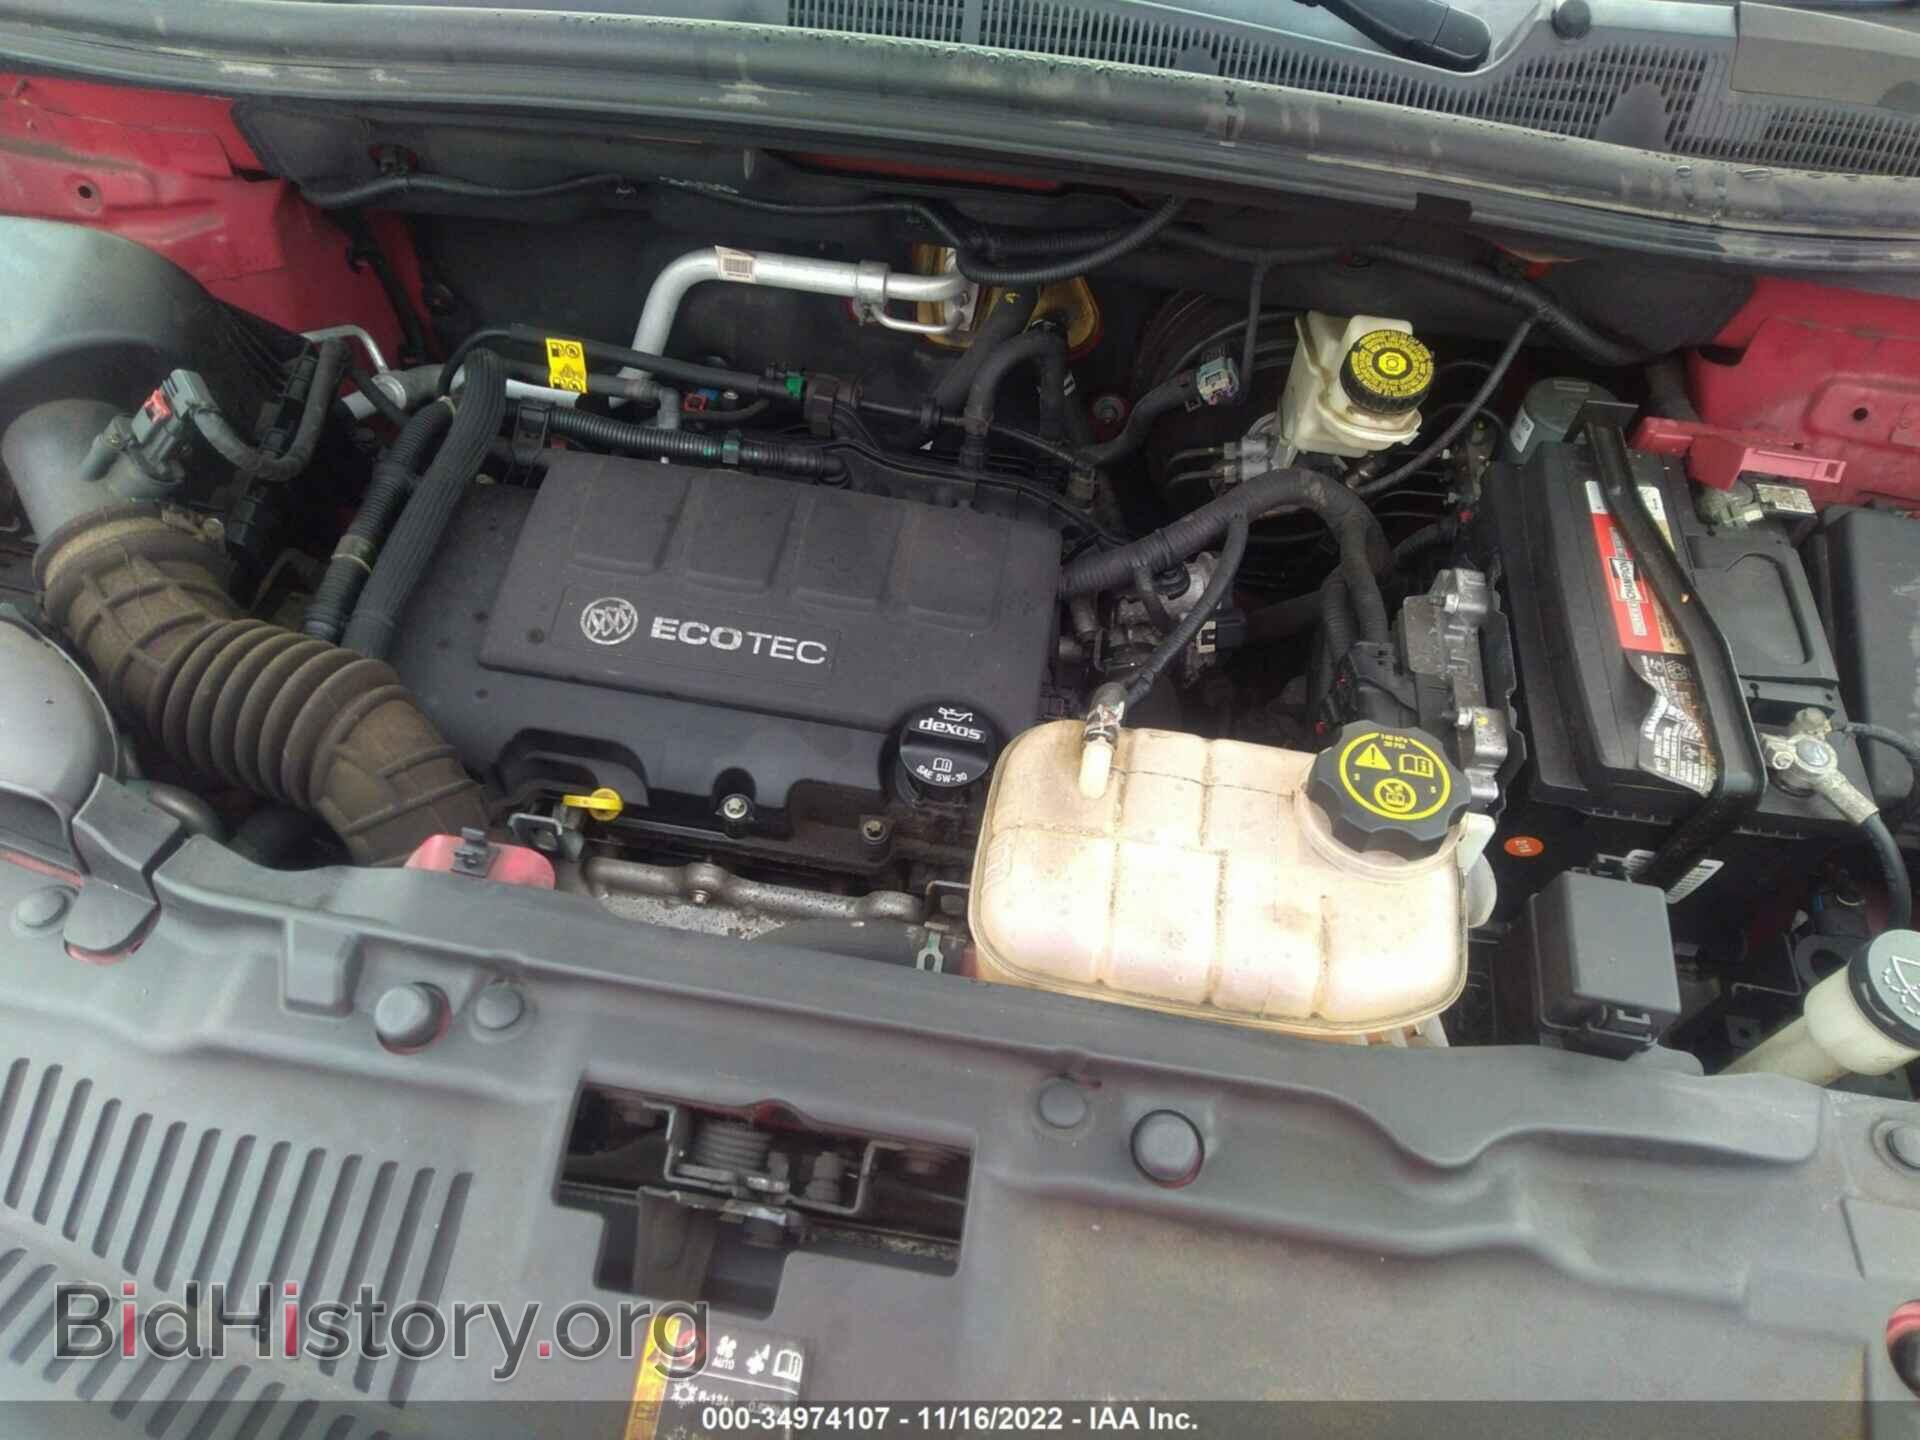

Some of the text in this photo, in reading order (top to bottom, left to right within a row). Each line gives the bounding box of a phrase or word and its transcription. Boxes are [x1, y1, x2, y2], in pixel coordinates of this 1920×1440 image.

[650, 616, 828, 665] ECOTEC
[918, 717, 985, 740] dexos
[916, 765, 968, 783] SAE 5W-30
